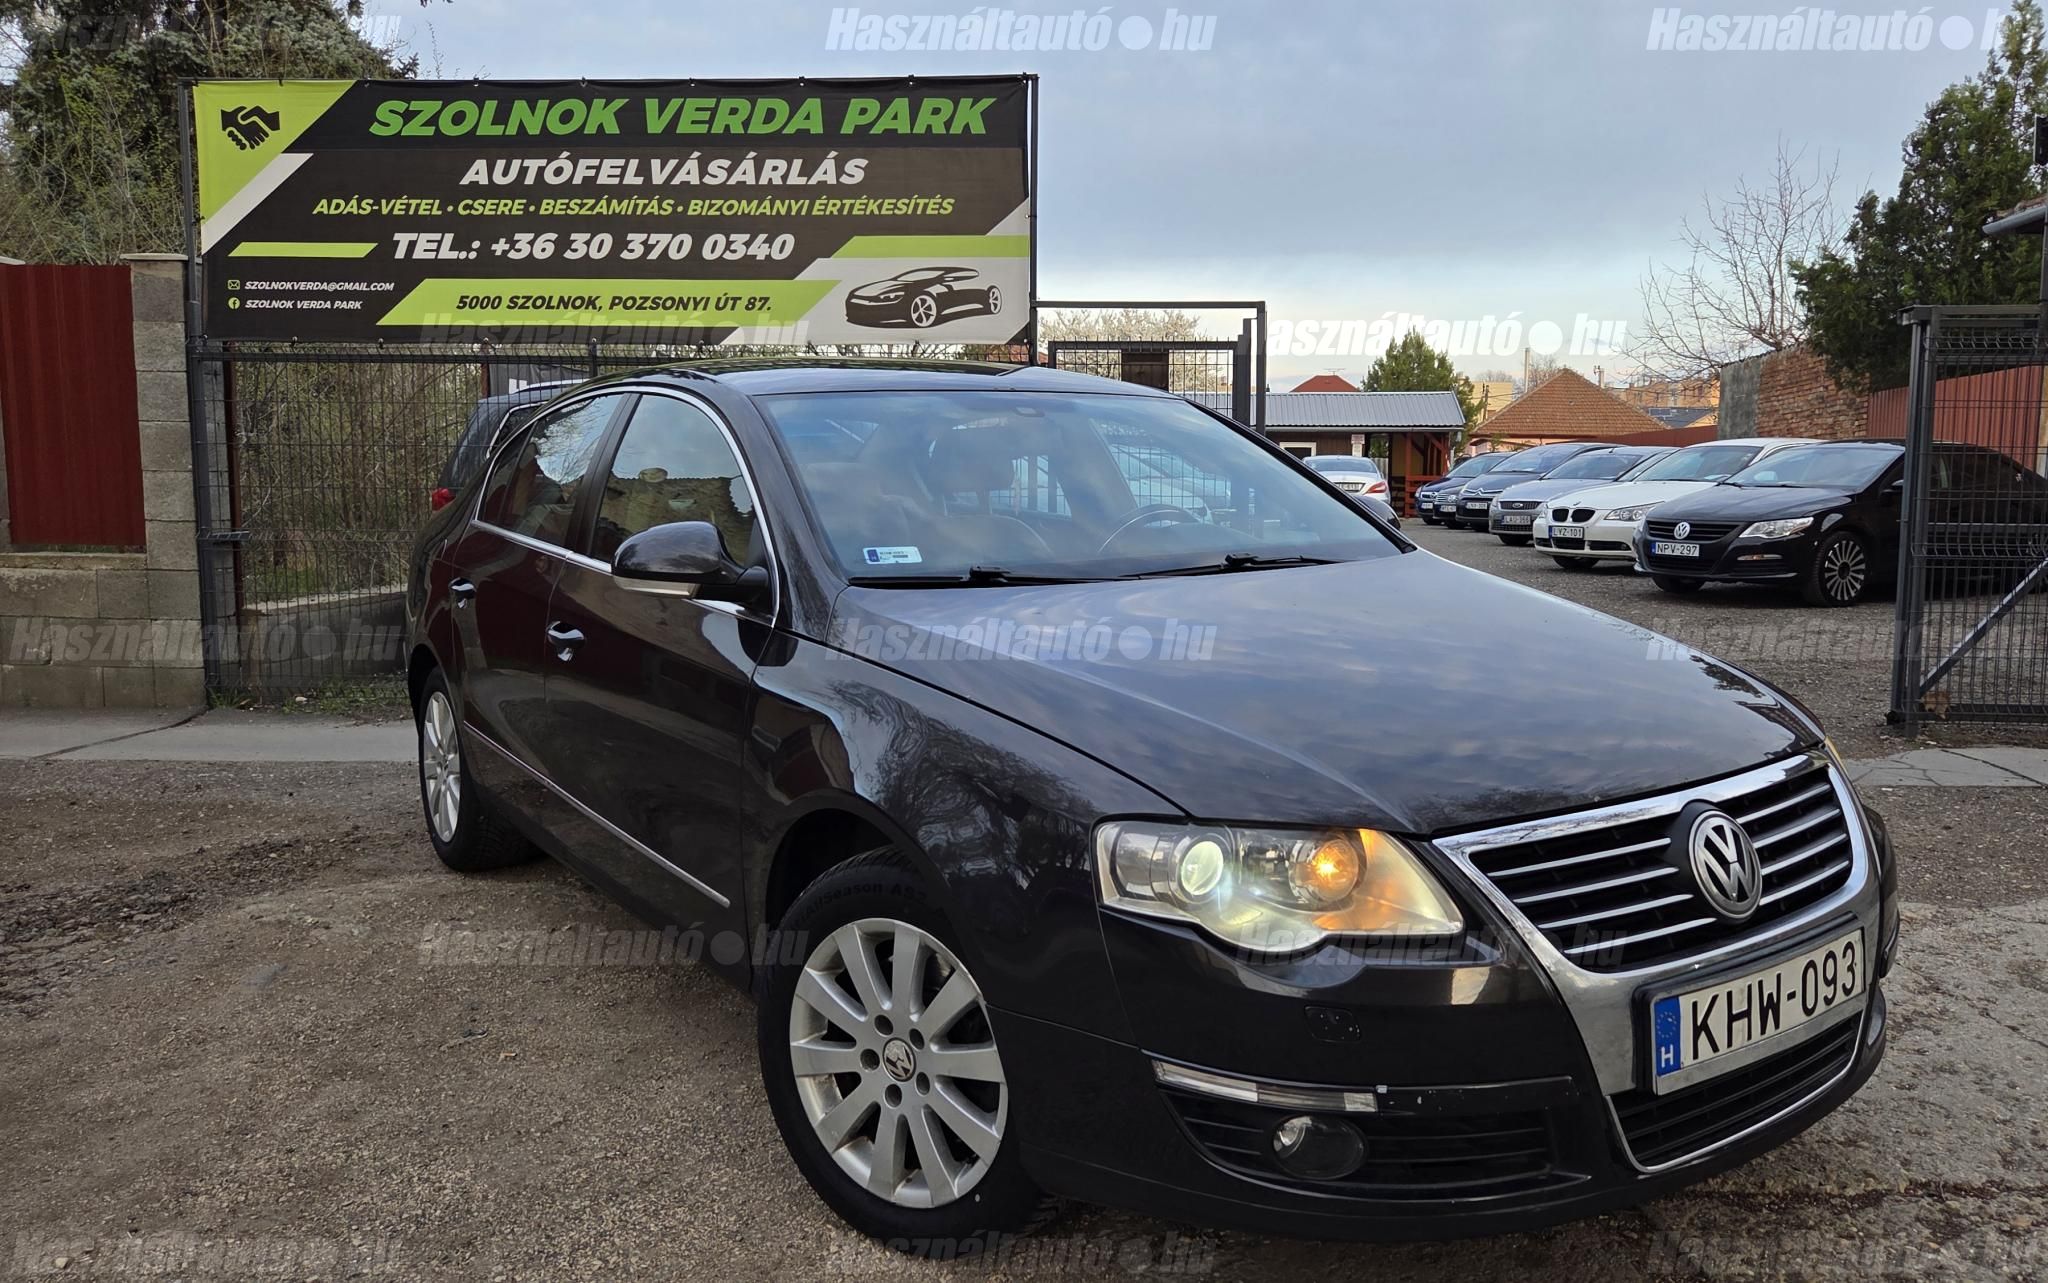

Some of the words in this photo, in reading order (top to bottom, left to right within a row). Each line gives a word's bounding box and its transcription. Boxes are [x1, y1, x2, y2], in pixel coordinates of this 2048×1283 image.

[369, 98, 629, 137] SZOLNOK
[644, 97, 824, 135] VERDA
[840, 97, 998, 135] PARK
[459, 151, 869, 186] AUTÓFELVÁSÁRLÁS
[312, 195, 443, 216] ADÁS-VÉTEL
[457, 199, 525, 215] CSERE
[539, 195, 673, 216] BESZÁMÍTÁS
[687, 195, 808, 216] BIZOMÁNYI
[812, 194, 955, 216] ÉRTÉKESÍTÉS
[391, 232, 481, 260] TEL.:
[490, 232, 558, 260] +36
[563, 232, 613, 260] 30
[620, 232, 694, 261] 370
[702, 232, 796, 261] 0340
[244, 281, 395, 292] SZOLNOKVERDA@GMAIL.COM
[245, 300, 295, 309] SZOLNOK
[297, 300, 331, 310] VERDA
[333, 301, 363, 310] PARK
[456, 295, 503, 310] 5000
[506, 295, 604, 312] SZOLNOK,
[609, 296, 708, 311] POZSONYI
[714, 292, 741, 310] ÚT
[744, 296, 772, 311] 87.
[1657, 544, 1697, 556] NPV-297
[1691, 941, 1857, 1061] KHW-093
[1660, 1044, 1675, 1068] H
